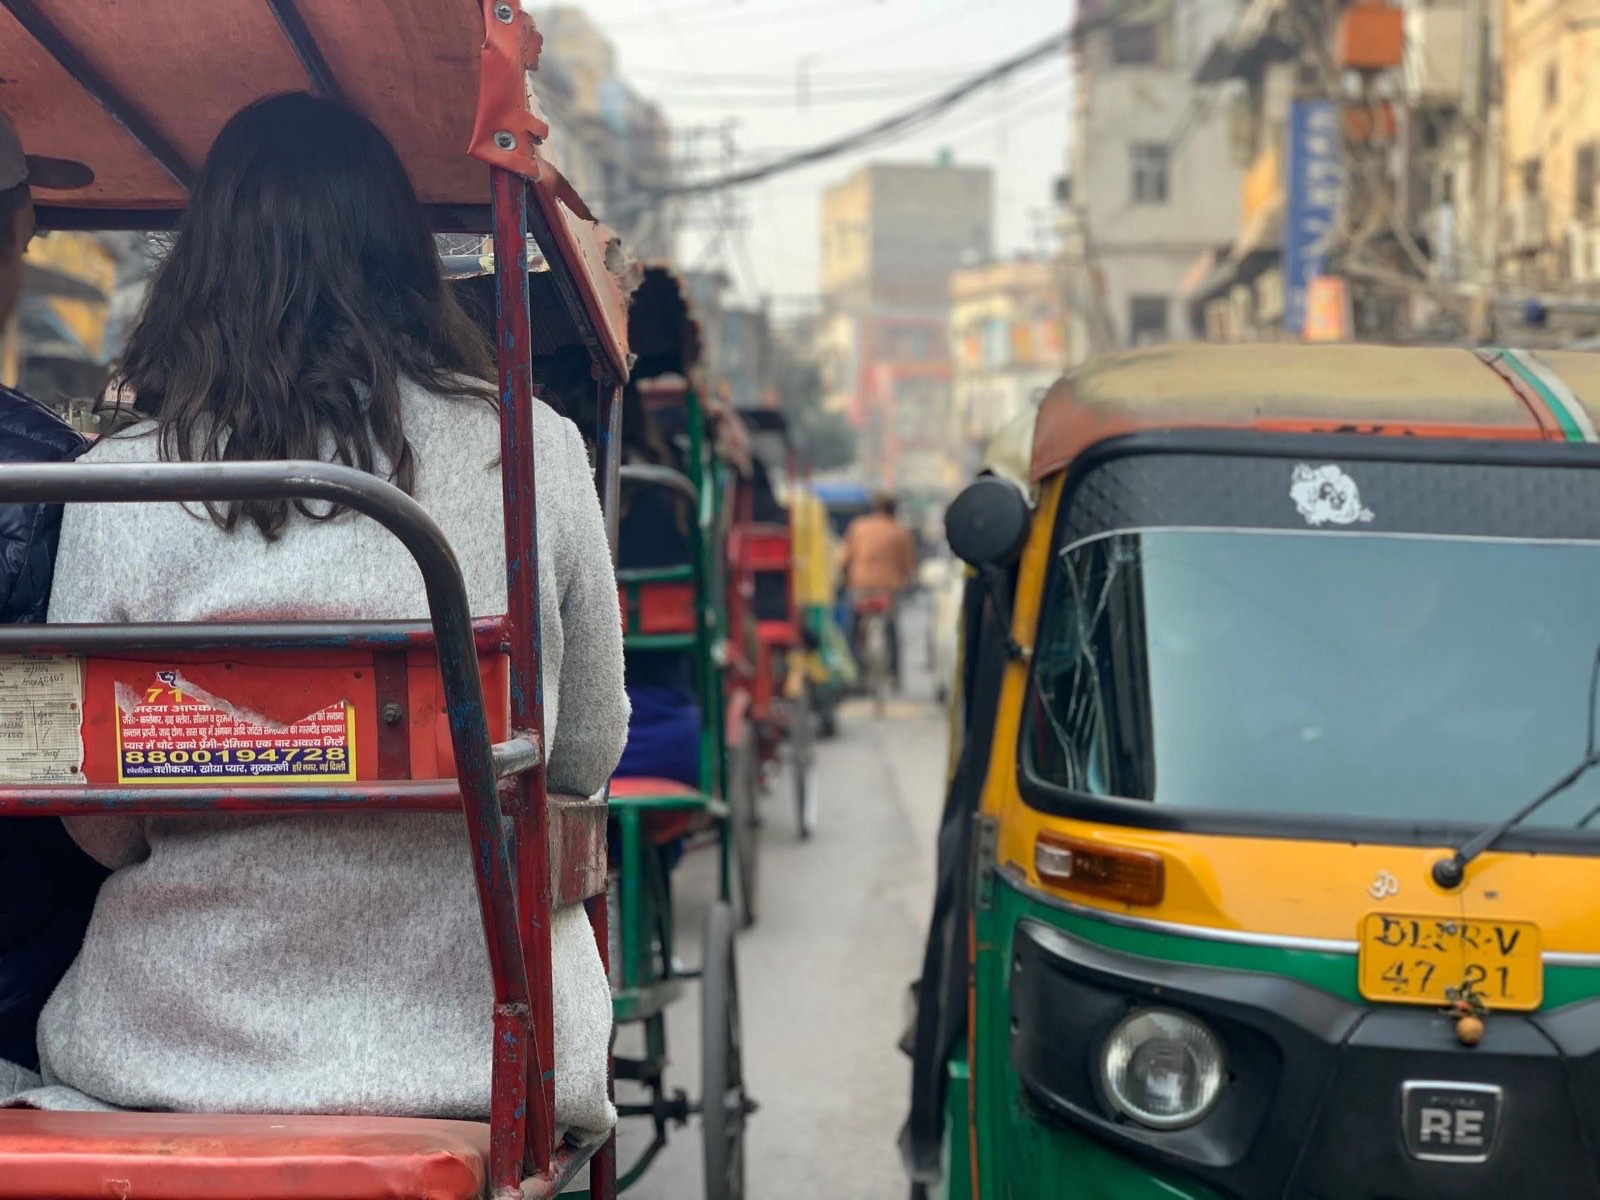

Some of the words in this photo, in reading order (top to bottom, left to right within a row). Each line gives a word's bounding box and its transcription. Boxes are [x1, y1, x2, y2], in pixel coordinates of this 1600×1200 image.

[124, 741, 144, 749] प्यार
[146, 739, 155, 749] में
[157, 739, 174, 749] चोट
[175, 739, 196, 749] खाये
[255, 739, 272, 748] एक
[274, 739, 291, 747] बार
[292, 738, 322, 747] अवश्य
[323, 735, 345, 747] मिलें
[125, 748, 345, 764] 8800194728
[153, 763, 197, 774] वशीकरण,
[200, 762, 223, 773] खोया
[225, 763, 247, 773] प्यार,
[1420, 1107, 1485, 1146] RE
